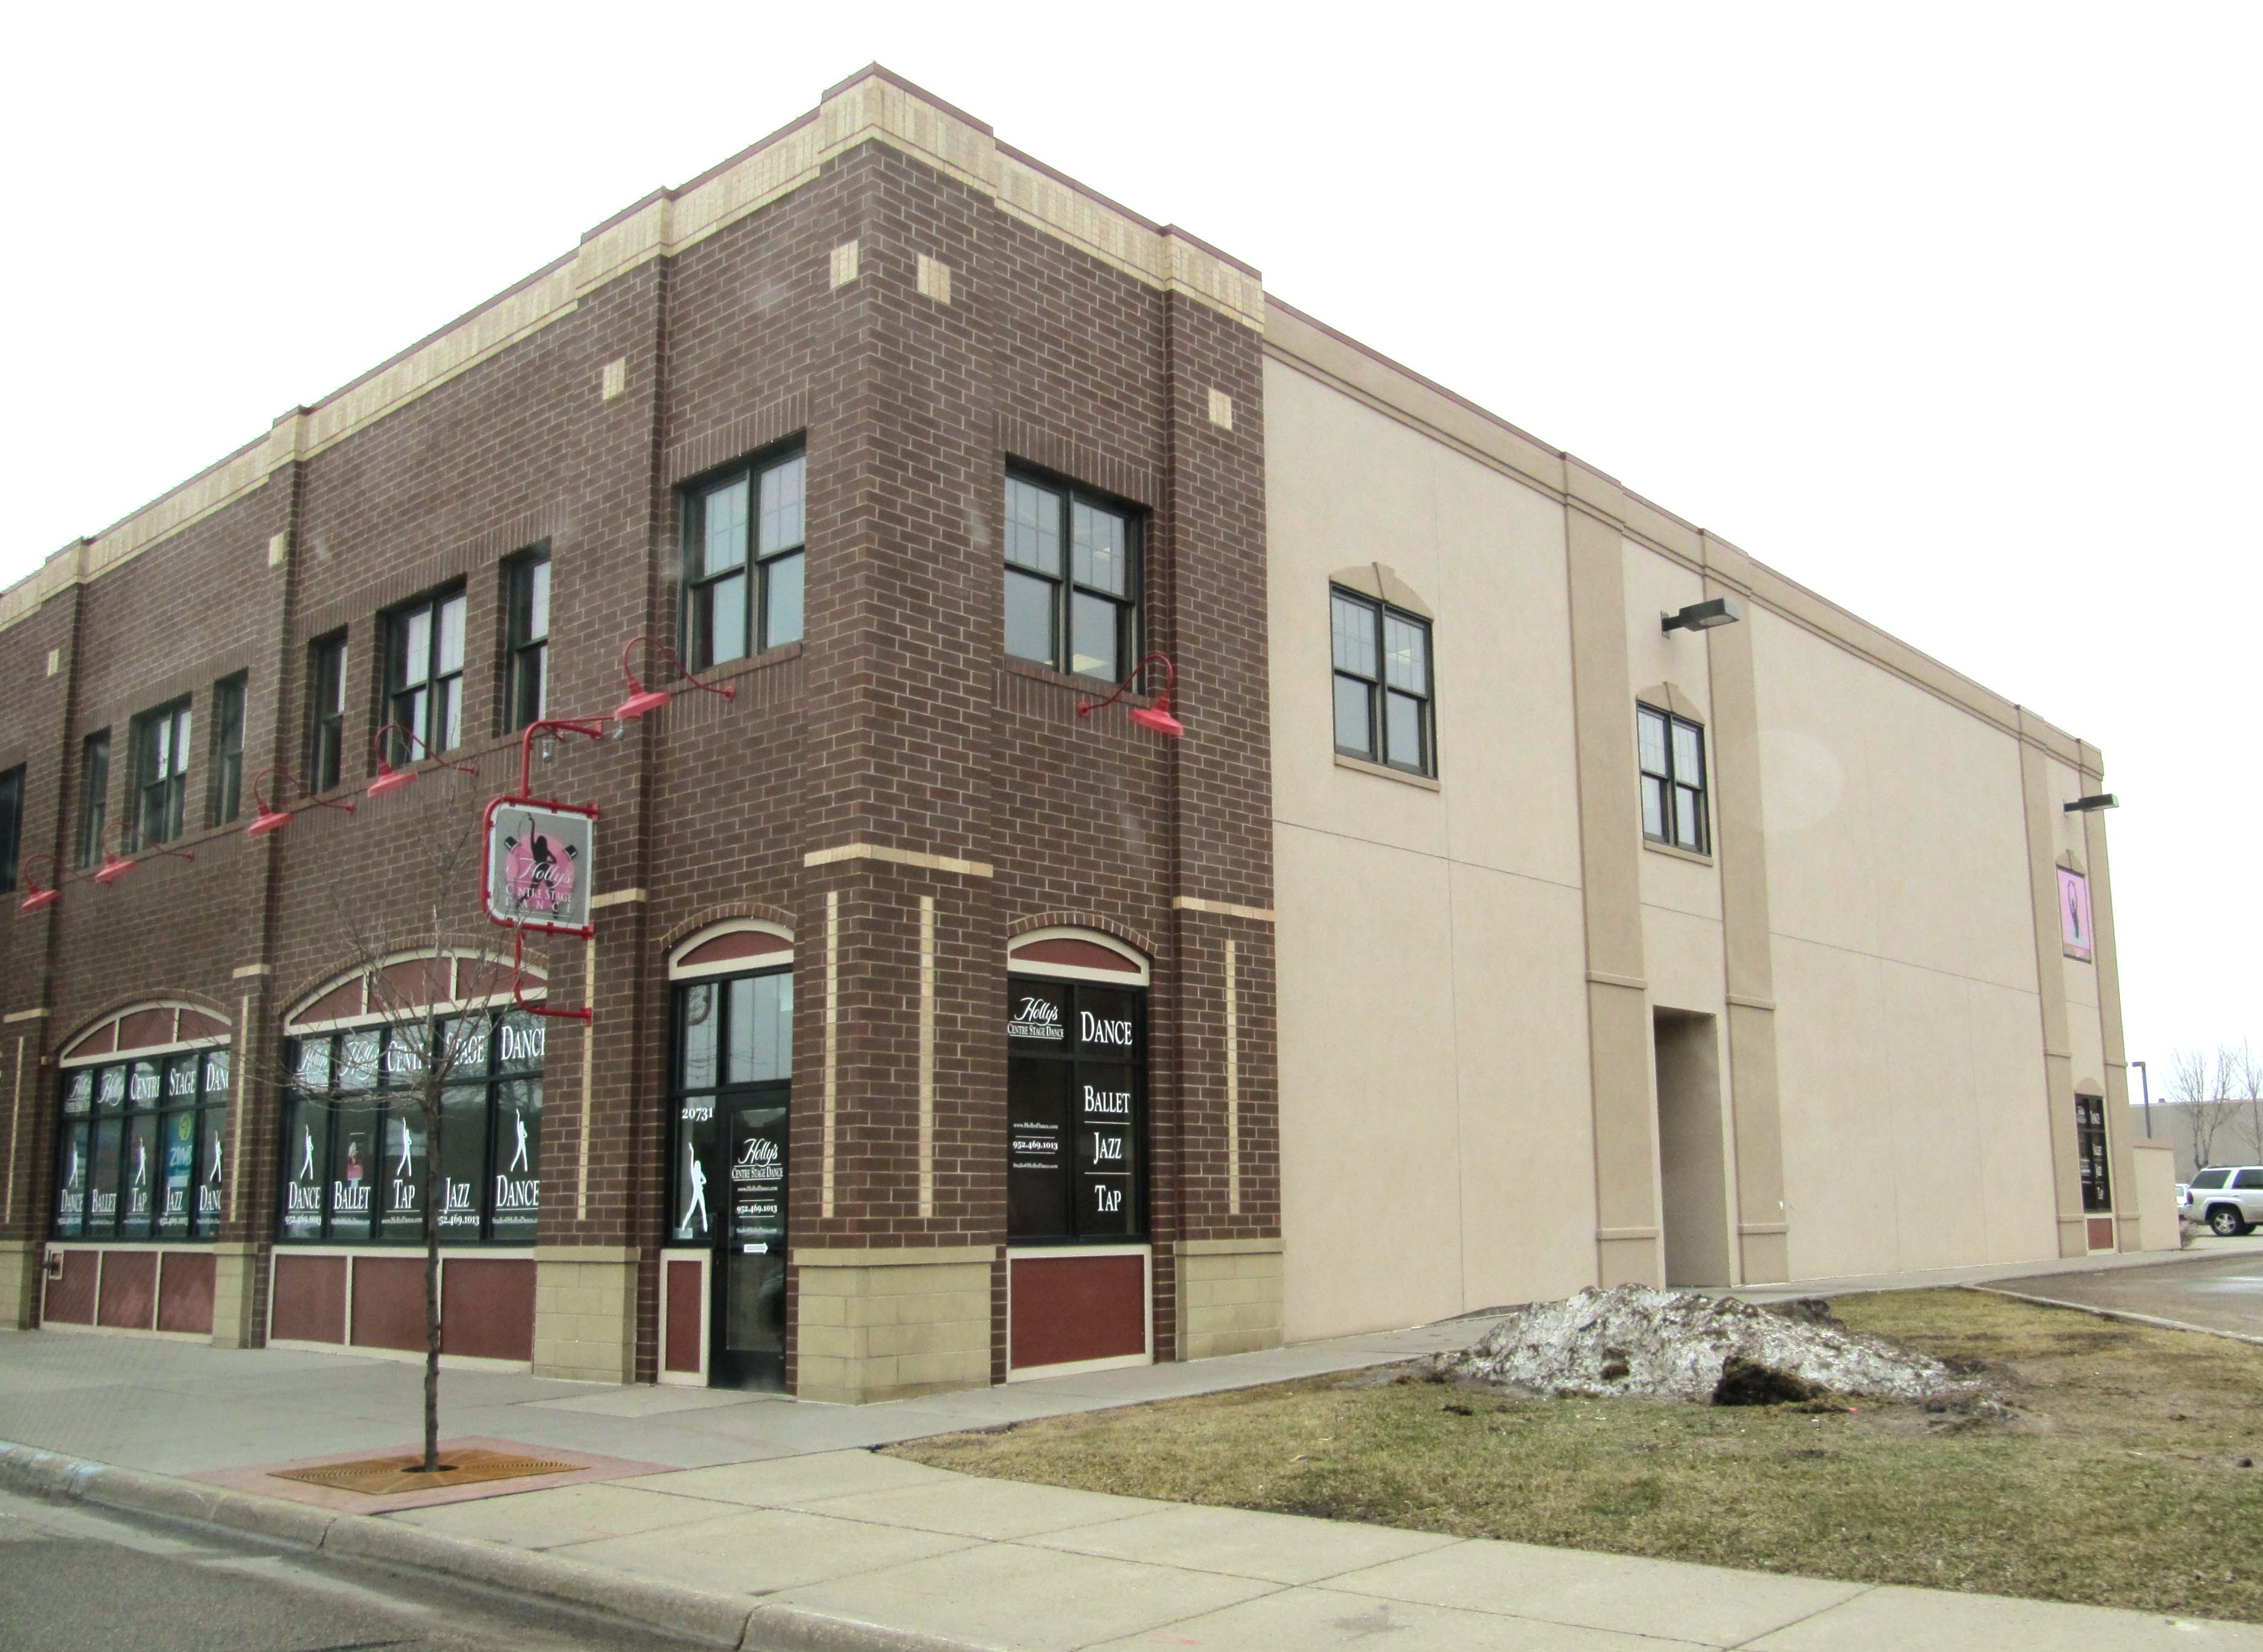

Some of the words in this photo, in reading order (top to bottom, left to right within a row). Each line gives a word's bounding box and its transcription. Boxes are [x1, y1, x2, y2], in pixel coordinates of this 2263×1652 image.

[1014, 997, 1058, 1026] Holly's
[1007, 1023, 1029, 1035] CENTRE
[1029, 1025, 1046, 1037] STAGE
[1046, 1026, 1064, 1038] DANCE
[1081, 1011, 1133, 1045] DANCE
[1084, 1086, 1130, 1113] BALLET
[682, 1107, 713, 1121] 20731
[738, 1138, 778, 1167] Holly's
[1013, 1140, 1058, 1151] 952.469.1013
[1093, 1132, 1122, 1164] JAZZ
[732, 1167, 751, 1179] CENTRE
[751, 1167, 766, 1179] STAGE
[766, 1166, 784, 1178] DANCE
[92, 1189, 117, 1212] BALLET
[132, 1188, 147, 1212] TAP
[165, 1186, 183, 1216] JAZZ
[289, 1182, 321, 1209] DANCE
[333, 1181, 371, 1209] BALLET
[394, 1179, 415, 1209] TAP
[444, 1177, 470, 1214] JAZZ
[496, 1174, 540, 1206] DANCE
[1095, 1185, 1121, 1212] TAP
